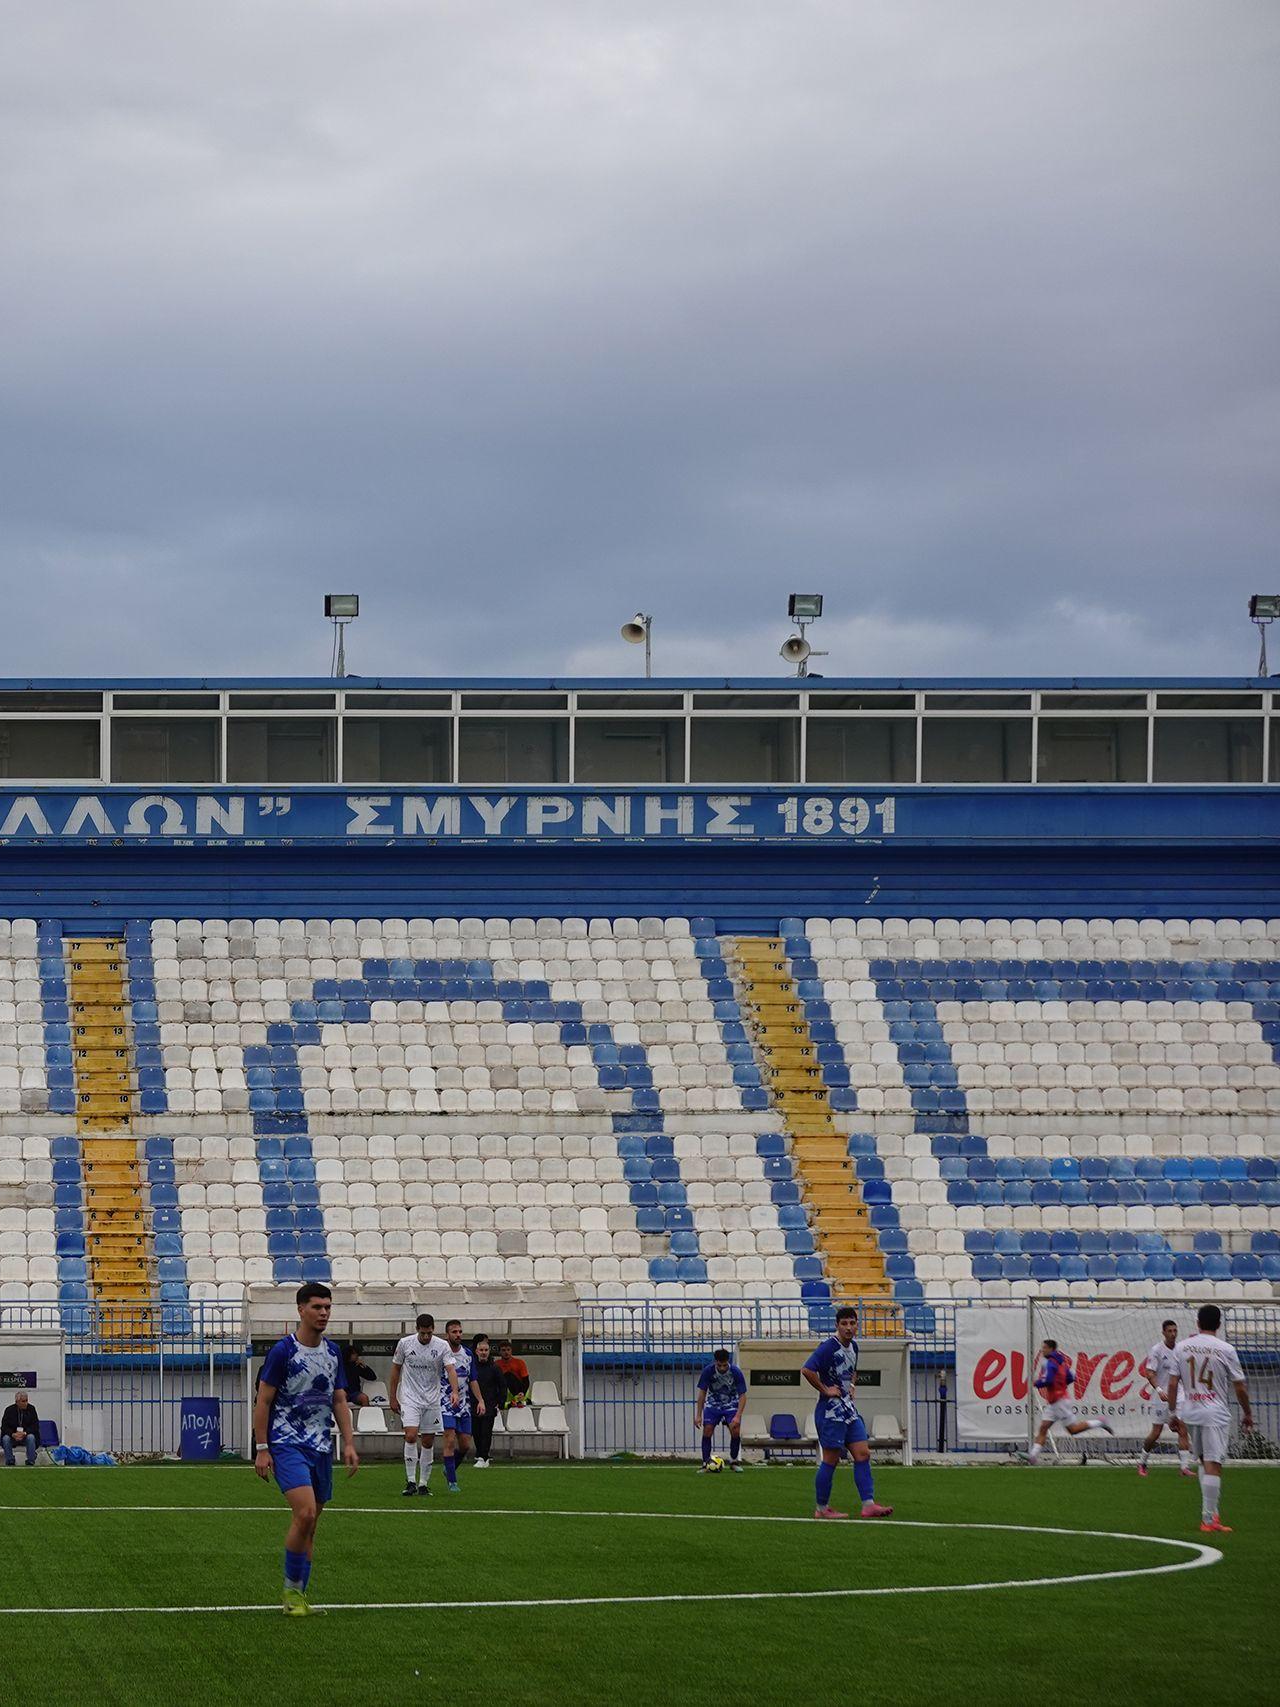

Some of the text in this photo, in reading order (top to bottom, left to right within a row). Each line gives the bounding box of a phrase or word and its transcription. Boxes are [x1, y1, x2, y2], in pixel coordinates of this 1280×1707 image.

[346, 796, 754, 835] ΣΜΥΡΝΗΣ
[777, 796, 896, 835] 1891
[814, 1092, 823, 1100] 10
[1187, 1356, 1213, 1390] 14
[1071, 1403, 1125, 1415] oasted
[198, 1432, 212, 1449] 7
